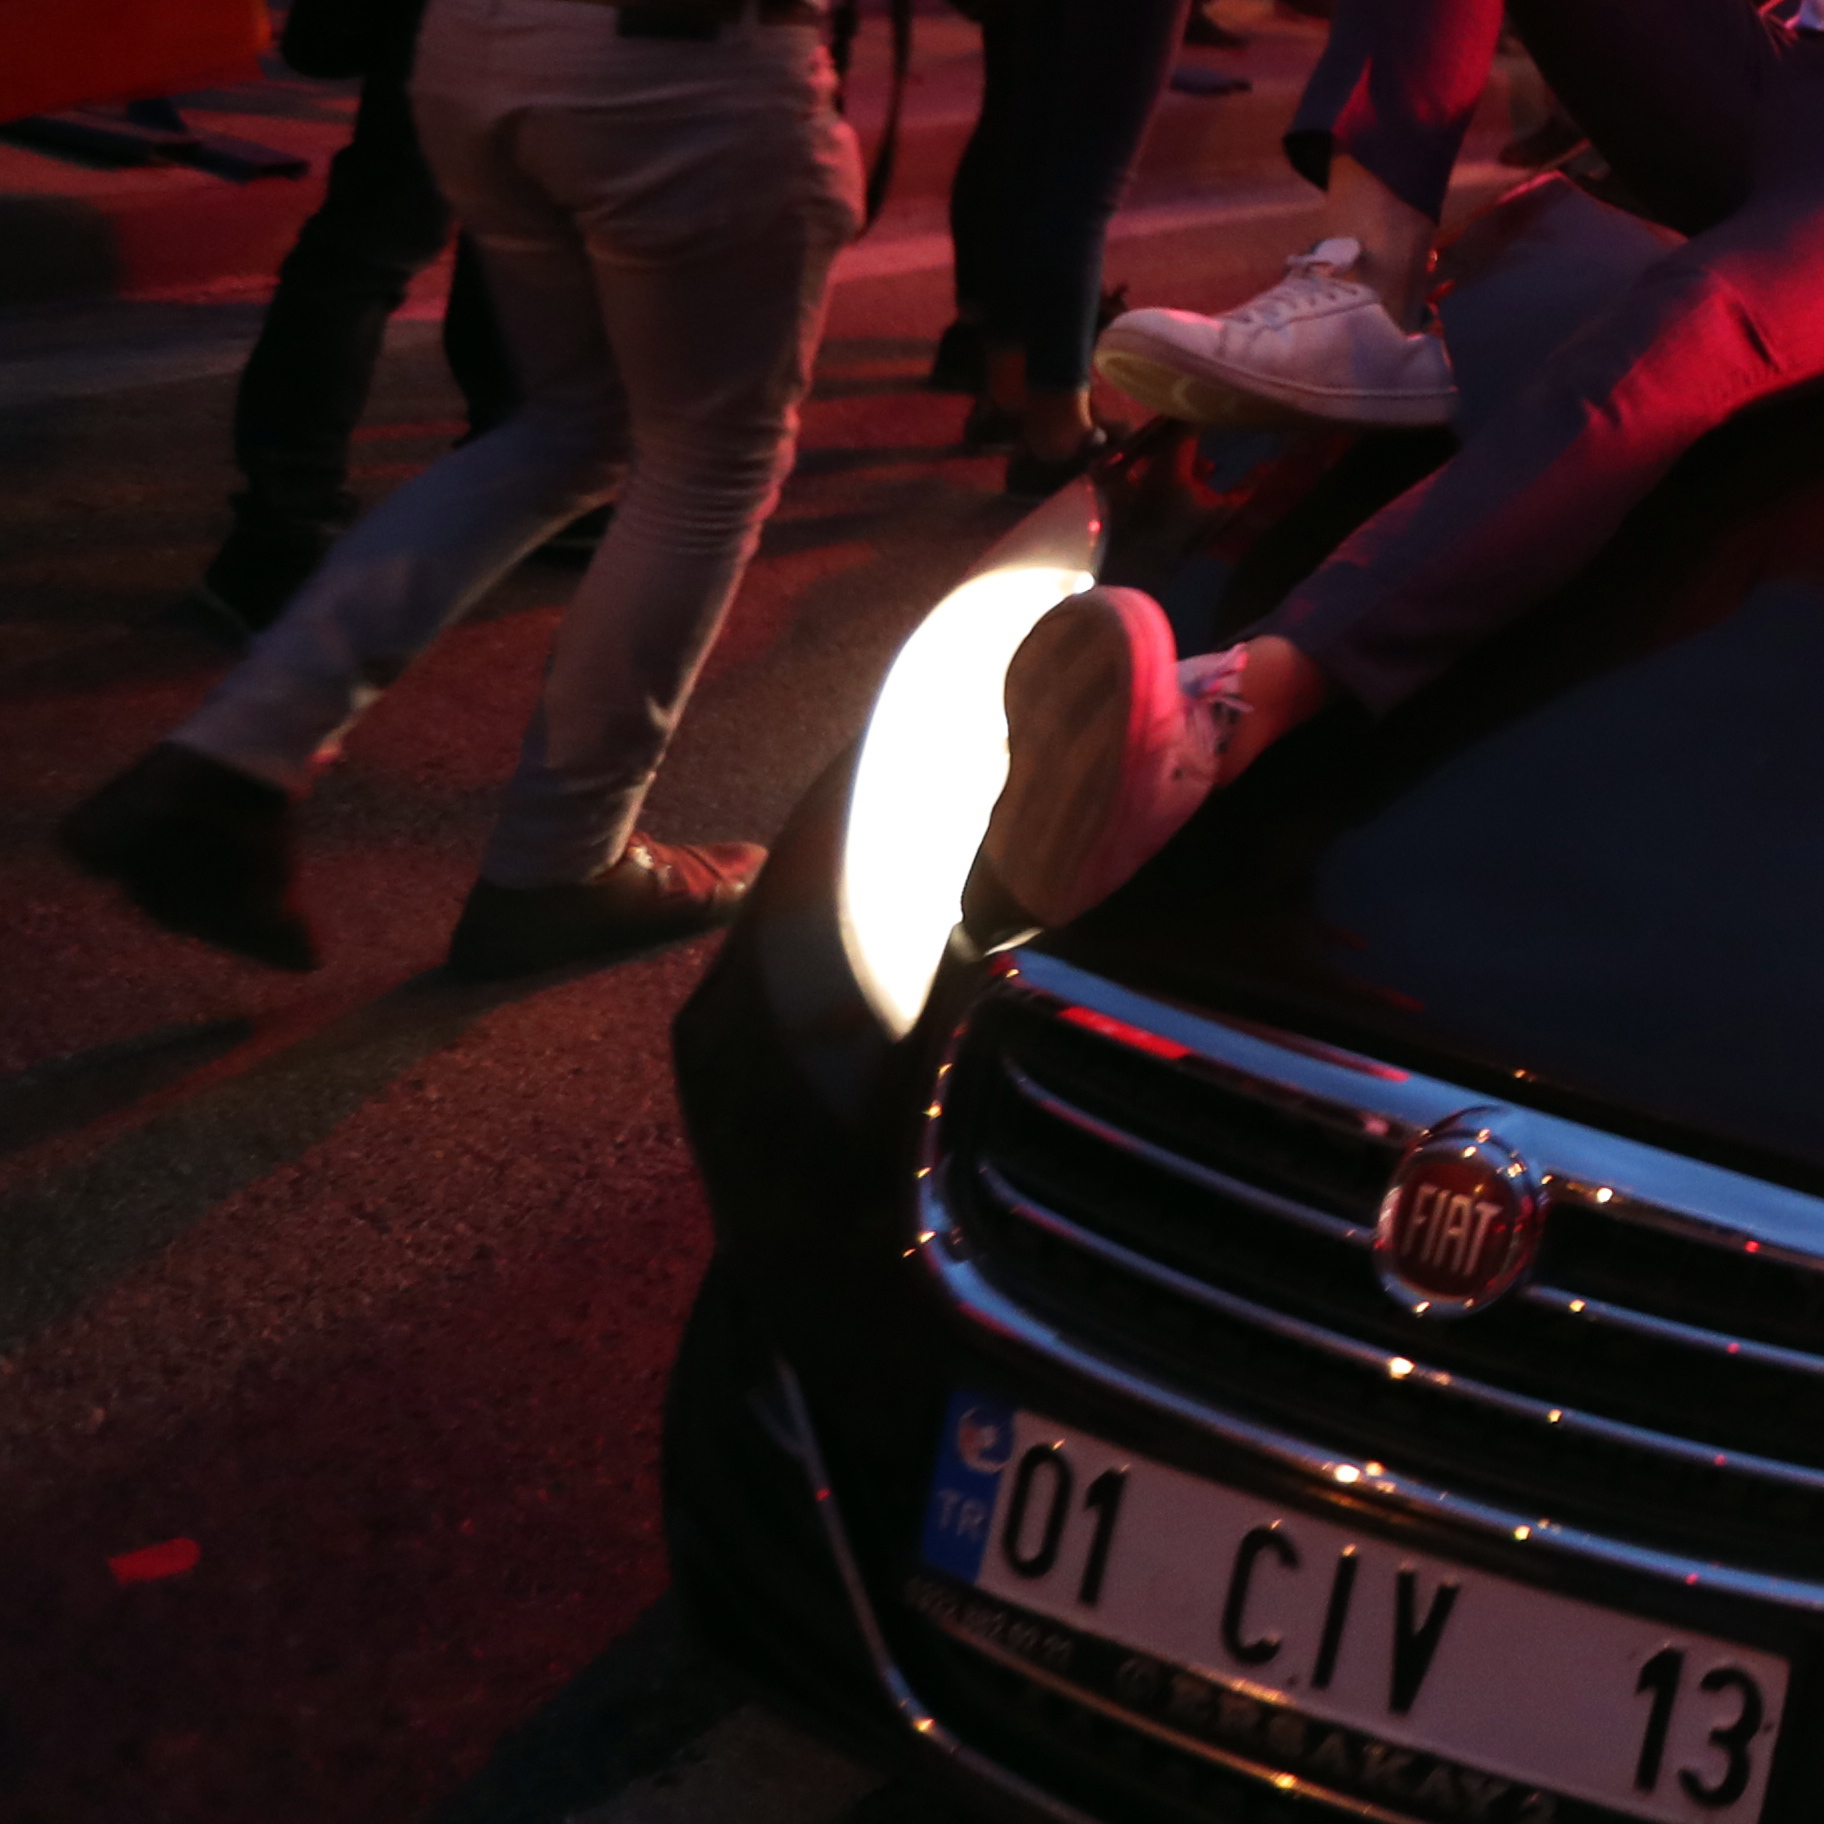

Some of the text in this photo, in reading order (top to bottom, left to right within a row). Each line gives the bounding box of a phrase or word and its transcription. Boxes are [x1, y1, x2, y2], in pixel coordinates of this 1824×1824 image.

[1401, 1182, 1504, 1277] FIAT
[937, 1488, 987, 1542] TR
[1004, 1443, 1131, 1606] 01
[1222, 1526, 1460, 1715] CIV
[1635, 1647, 1763, 1808] 13
